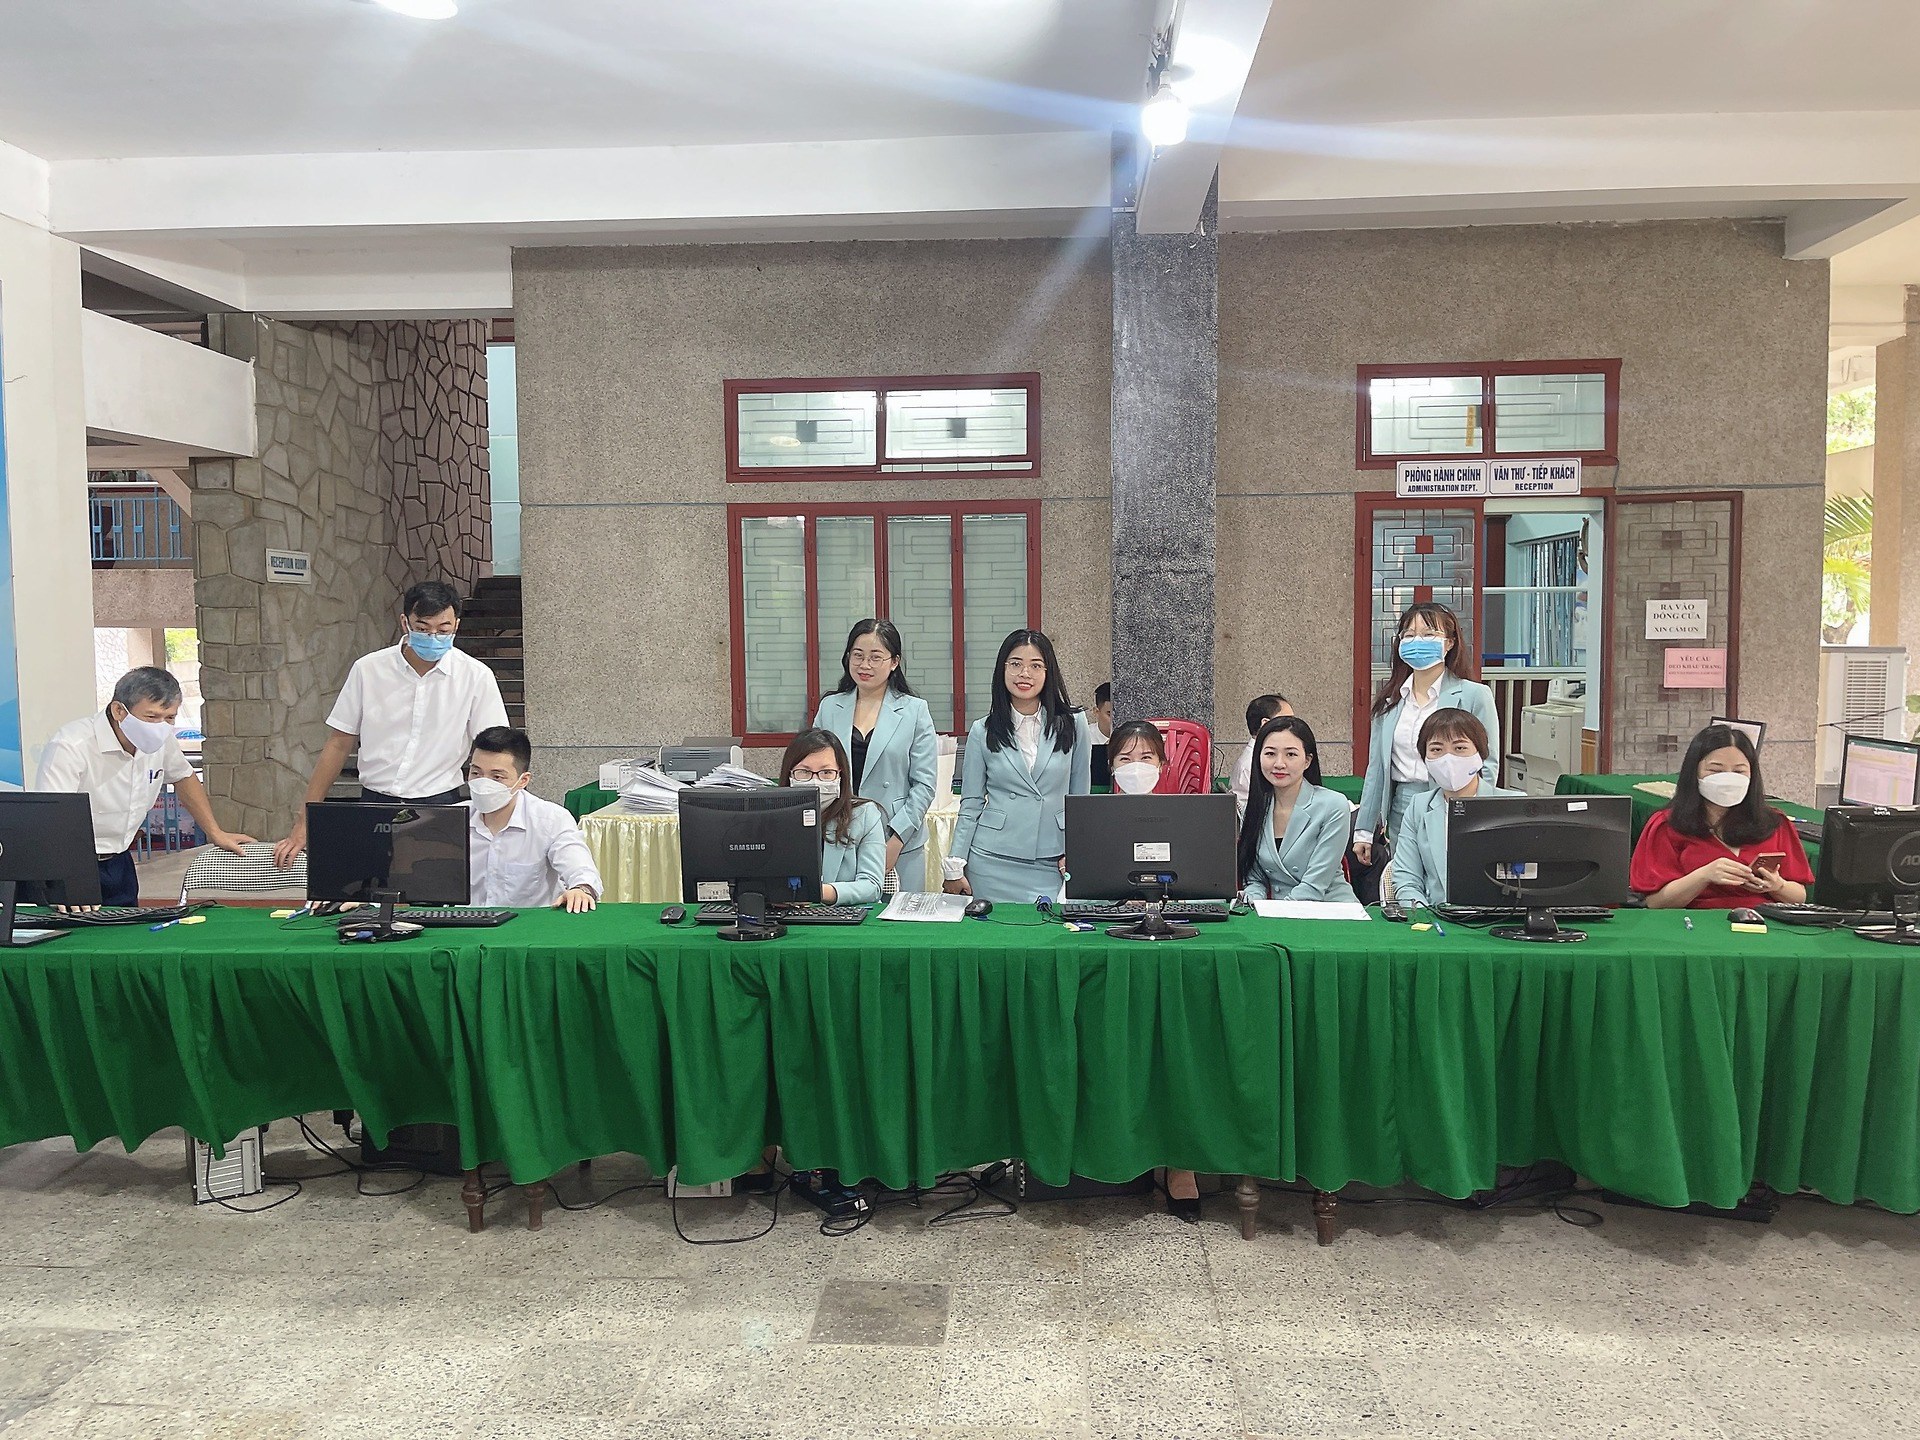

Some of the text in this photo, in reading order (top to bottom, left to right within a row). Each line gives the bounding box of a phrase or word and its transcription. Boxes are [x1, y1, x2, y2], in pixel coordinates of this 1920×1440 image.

[1404, 465, 1481, 482] PHÒNG HÀNH CHÍNH
[1493, 465, 1509, 480] VĂN
[1510, 466, 1526, 480] THƯ
[1532, 462, 1548, 480] TIẾP
[1550, 464, 1575, 479] KHÁCH
[1407, 484, 1478, 493] ADMINISTRATION DEPT.
[1514, 483, 1554, 491] RECEPTION
[729, 843, 766, 851] SAMSUNG
